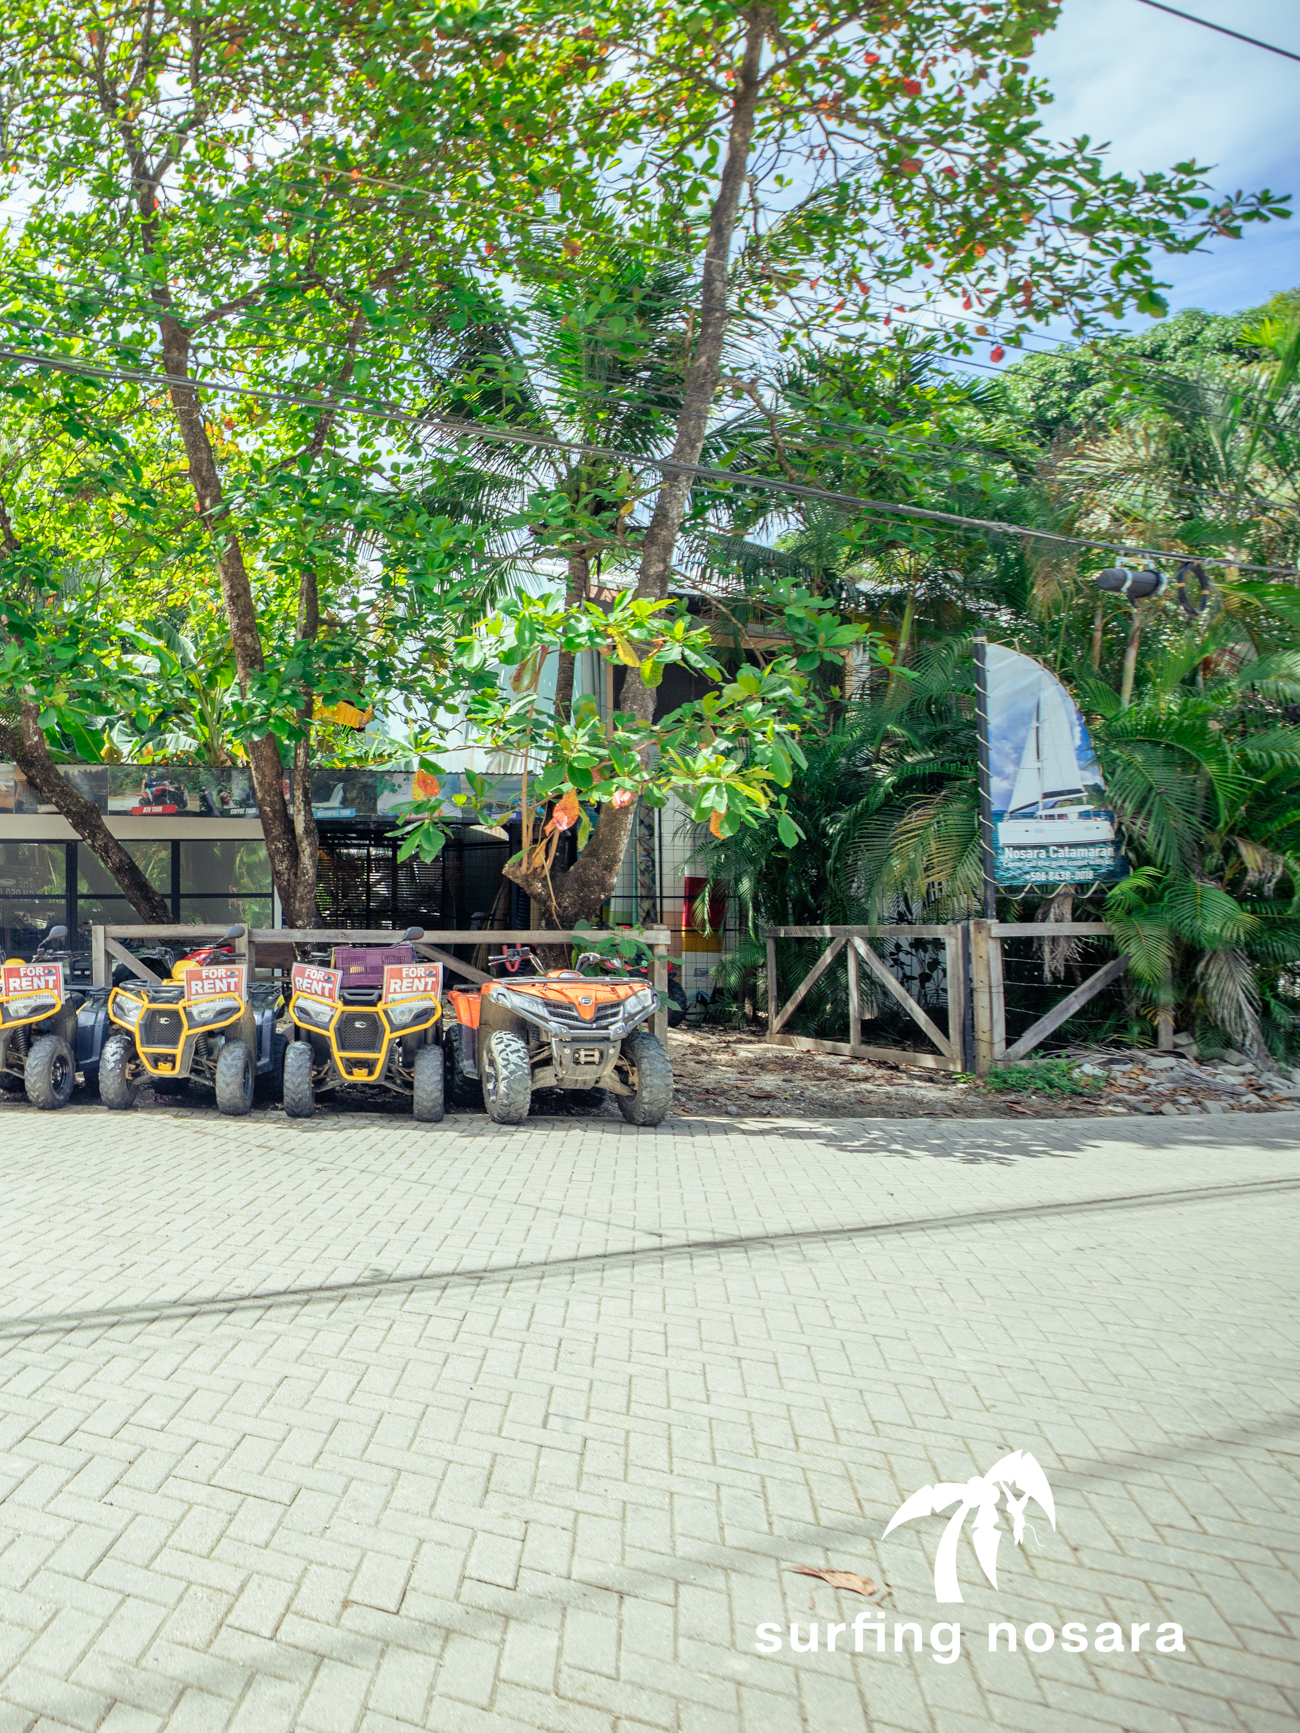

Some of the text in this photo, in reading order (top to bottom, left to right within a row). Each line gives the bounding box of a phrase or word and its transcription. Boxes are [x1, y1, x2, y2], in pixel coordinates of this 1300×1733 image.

[1004, 846, 1114, 859] Nosara Catamaran
[1027, 872, 1047, 881] +506
[20, 967, 44, 976] FOR
[202, 969, 226, 979] FOR
[305, 968, 325, 981] FOR
[402, 967, 425, 977] FOR
[8, 976, 56, 991] RENT
[191, 978, 238, 994] RENT
[295, 977, 333, 997] RENT
[389, 978, 436, 993] RENT
